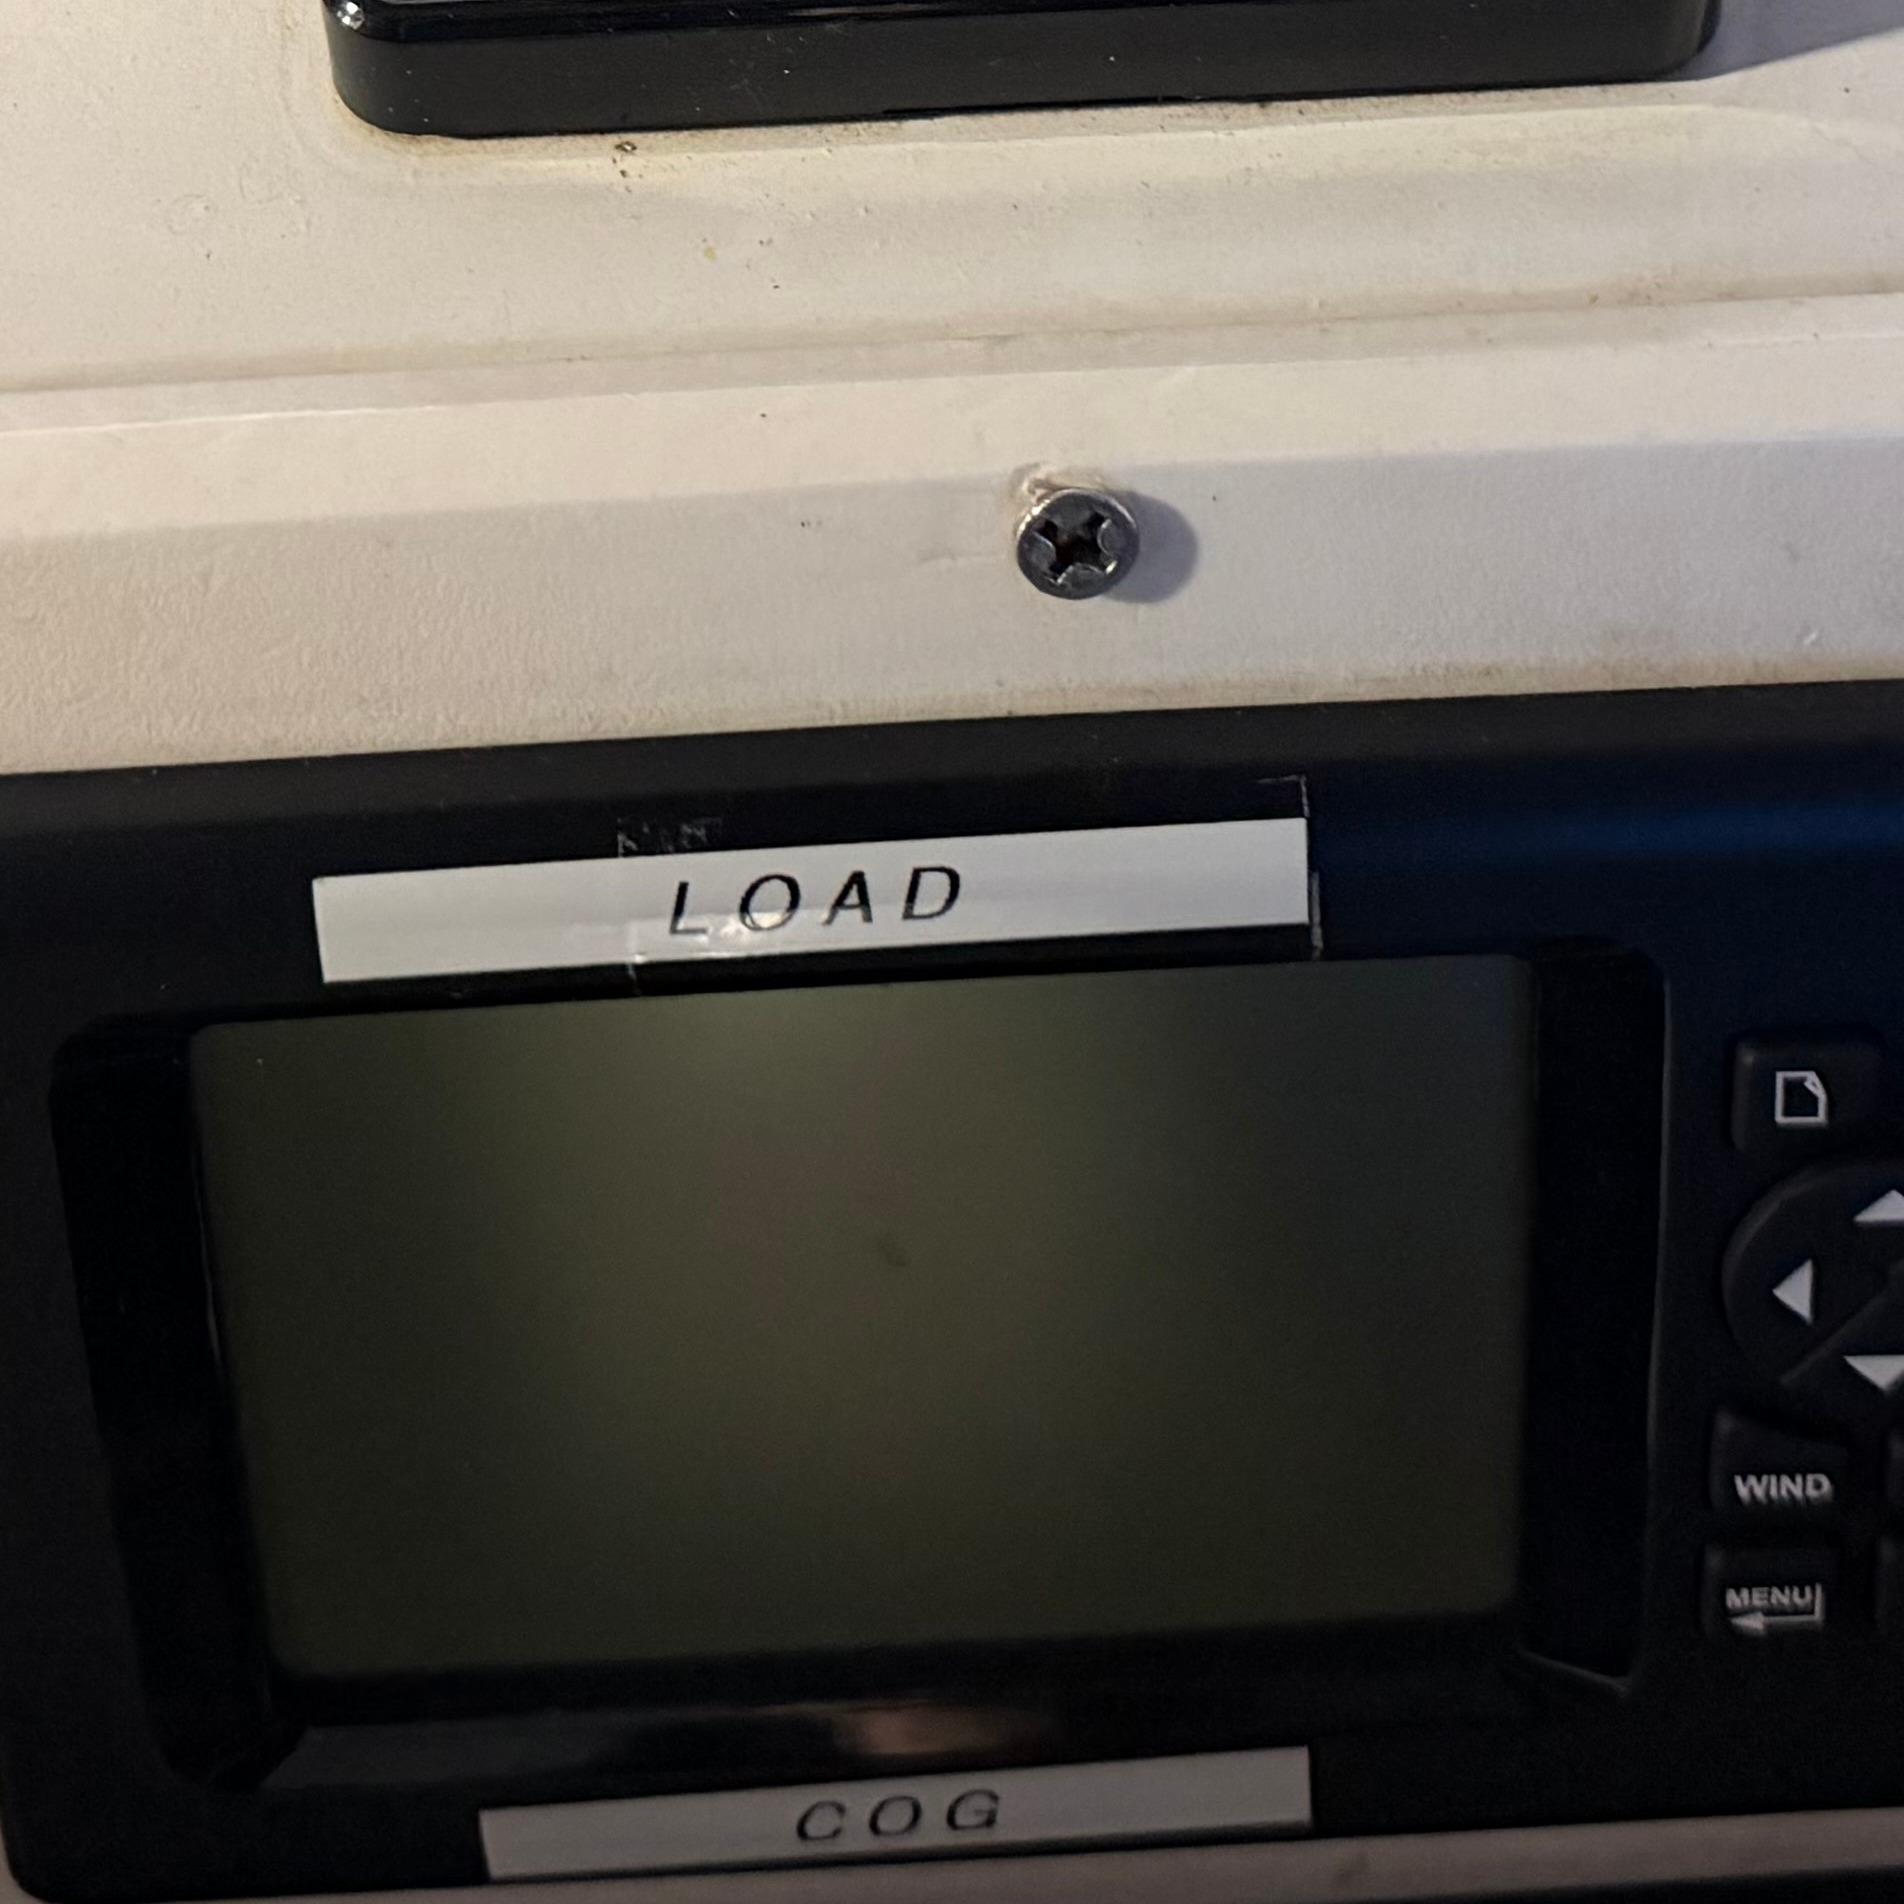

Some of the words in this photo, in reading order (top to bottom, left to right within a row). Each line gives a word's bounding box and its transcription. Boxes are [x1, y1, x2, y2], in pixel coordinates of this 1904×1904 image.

[668, 864, 962, 936] LOAD
[1733, 1472, 1834, 1506] WIND
[1724, 1586, 1814, 1612] MENU
[796, 1789, 1001, 1843] COG
